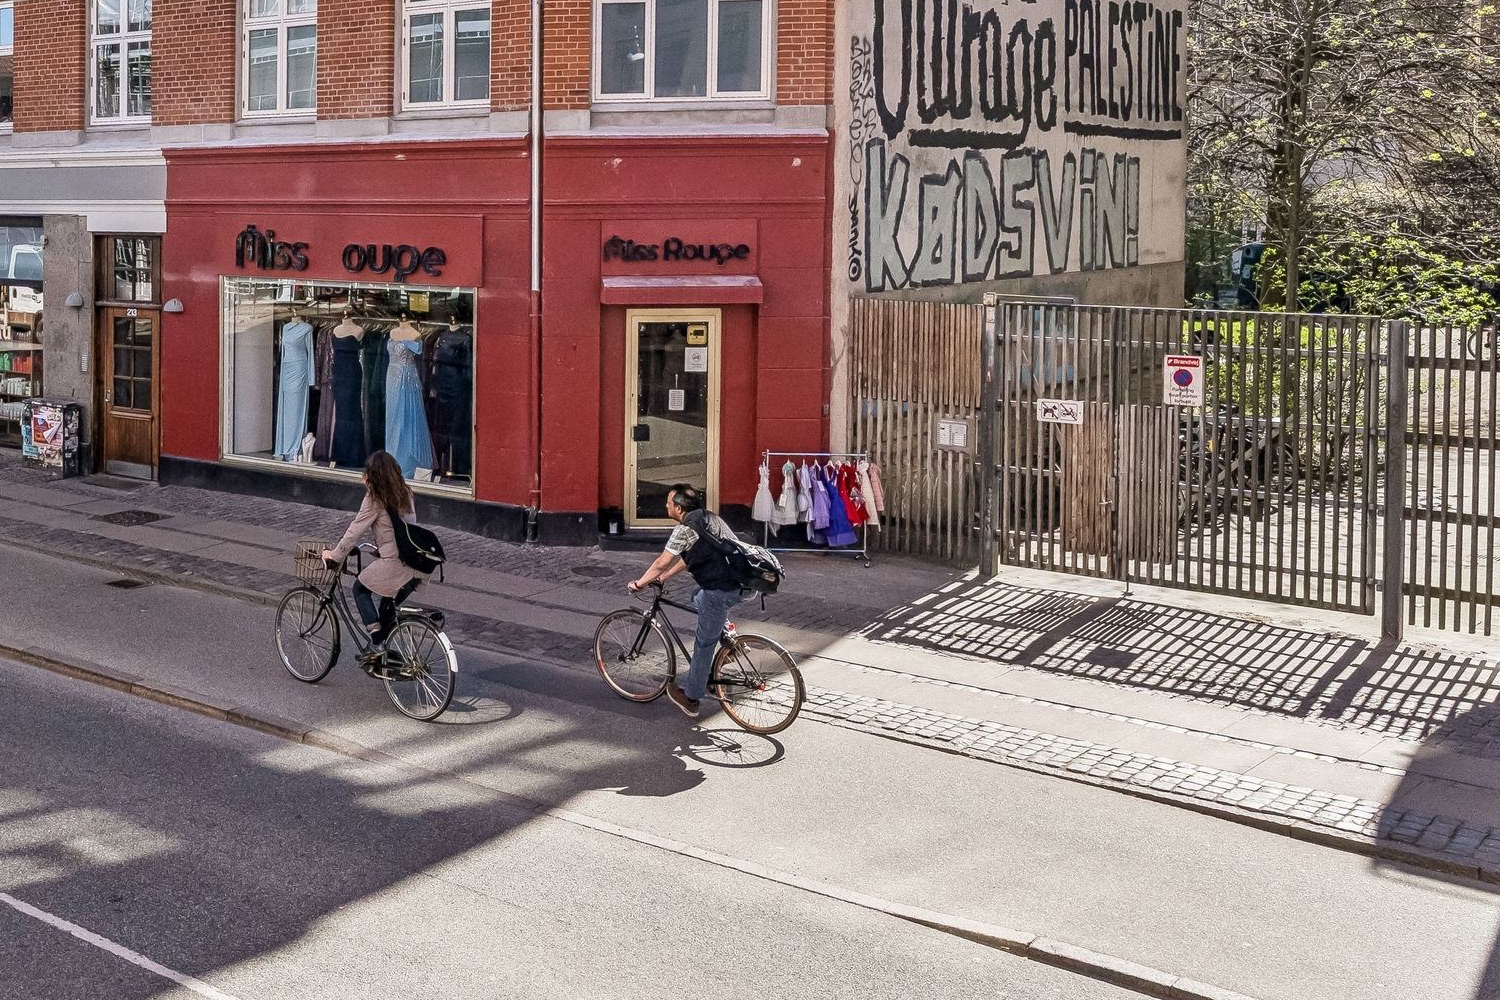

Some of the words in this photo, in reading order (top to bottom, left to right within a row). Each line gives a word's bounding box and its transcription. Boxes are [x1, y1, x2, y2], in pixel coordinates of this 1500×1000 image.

[236, 224, 309, 271] Miss
[603, 235, 660, 262] Miss
[1173, 358, 1199, 367] Brandvej
